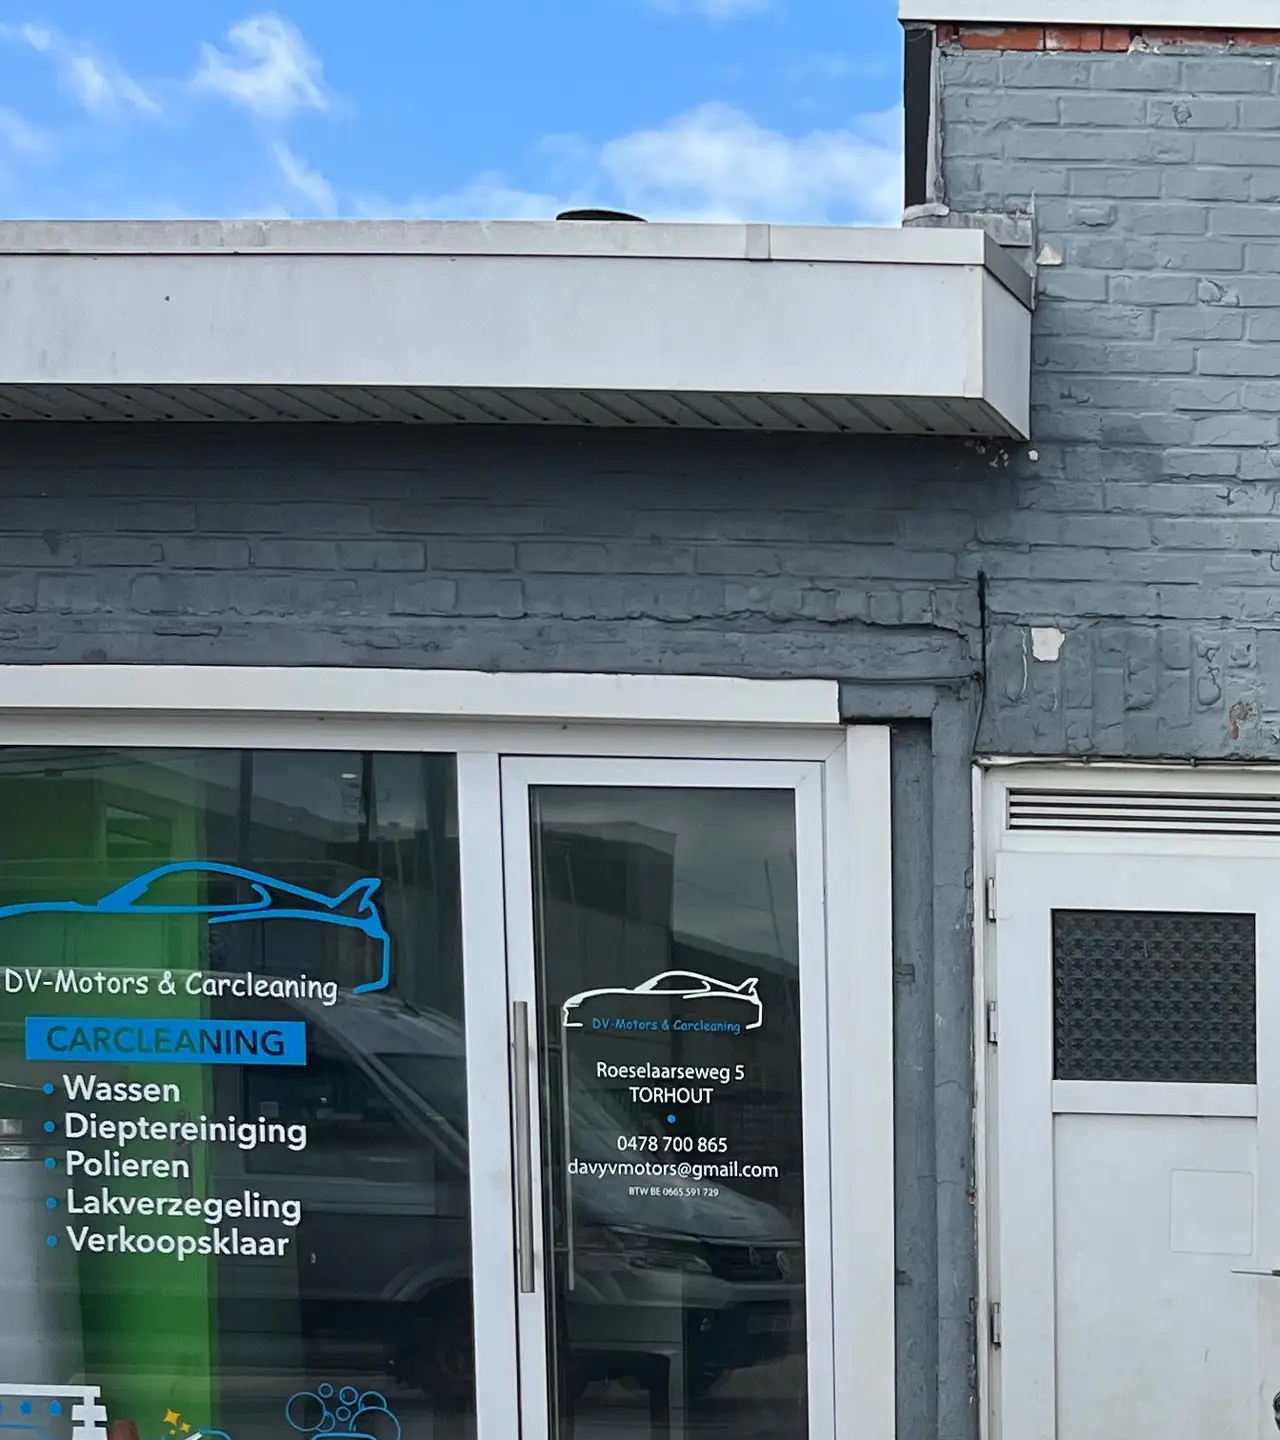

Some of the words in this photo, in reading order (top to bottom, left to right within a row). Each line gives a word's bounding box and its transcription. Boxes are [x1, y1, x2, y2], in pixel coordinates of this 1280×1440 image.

[4, 967, 149, 995] DV-Motors
[157, 970, 177, 996] &
[185, 971, 338, 1007] Carcleaning
[46, 1025, 285, 1057] CARCLEANING
[591, 1017, 657, 1031] DV-Motors
[661, 1019, 670, 1031] &
[673, 1019, 741, 1036] Carcleaning
[596, 1061, 730, 1084] Roeselaarseweg
[734, 1064, 745, 1081] 5
[62, 1074, 181, 1103] Wassen
[628, 1086, 714, 1104] TORHOUT
[65, 1112, 307, 1151] Dieptereiniging
[616, 1135, 659, 1152] 0478
[662, 1136, 694, 1153] 700
[697, 1136, 728, 1153] 865
[66, 1149, 190, 1179] Polieren
[567, 1158, 779, 1180] davyvmotors@gmail.com
[629, 1186, 648, 1197] BTW
[650, 1187, 661, 1197] BE
[67, 1188, 301, 1227] Lakverzegeling
[66, 1226, 290, 1261] Verkoopsklaar
